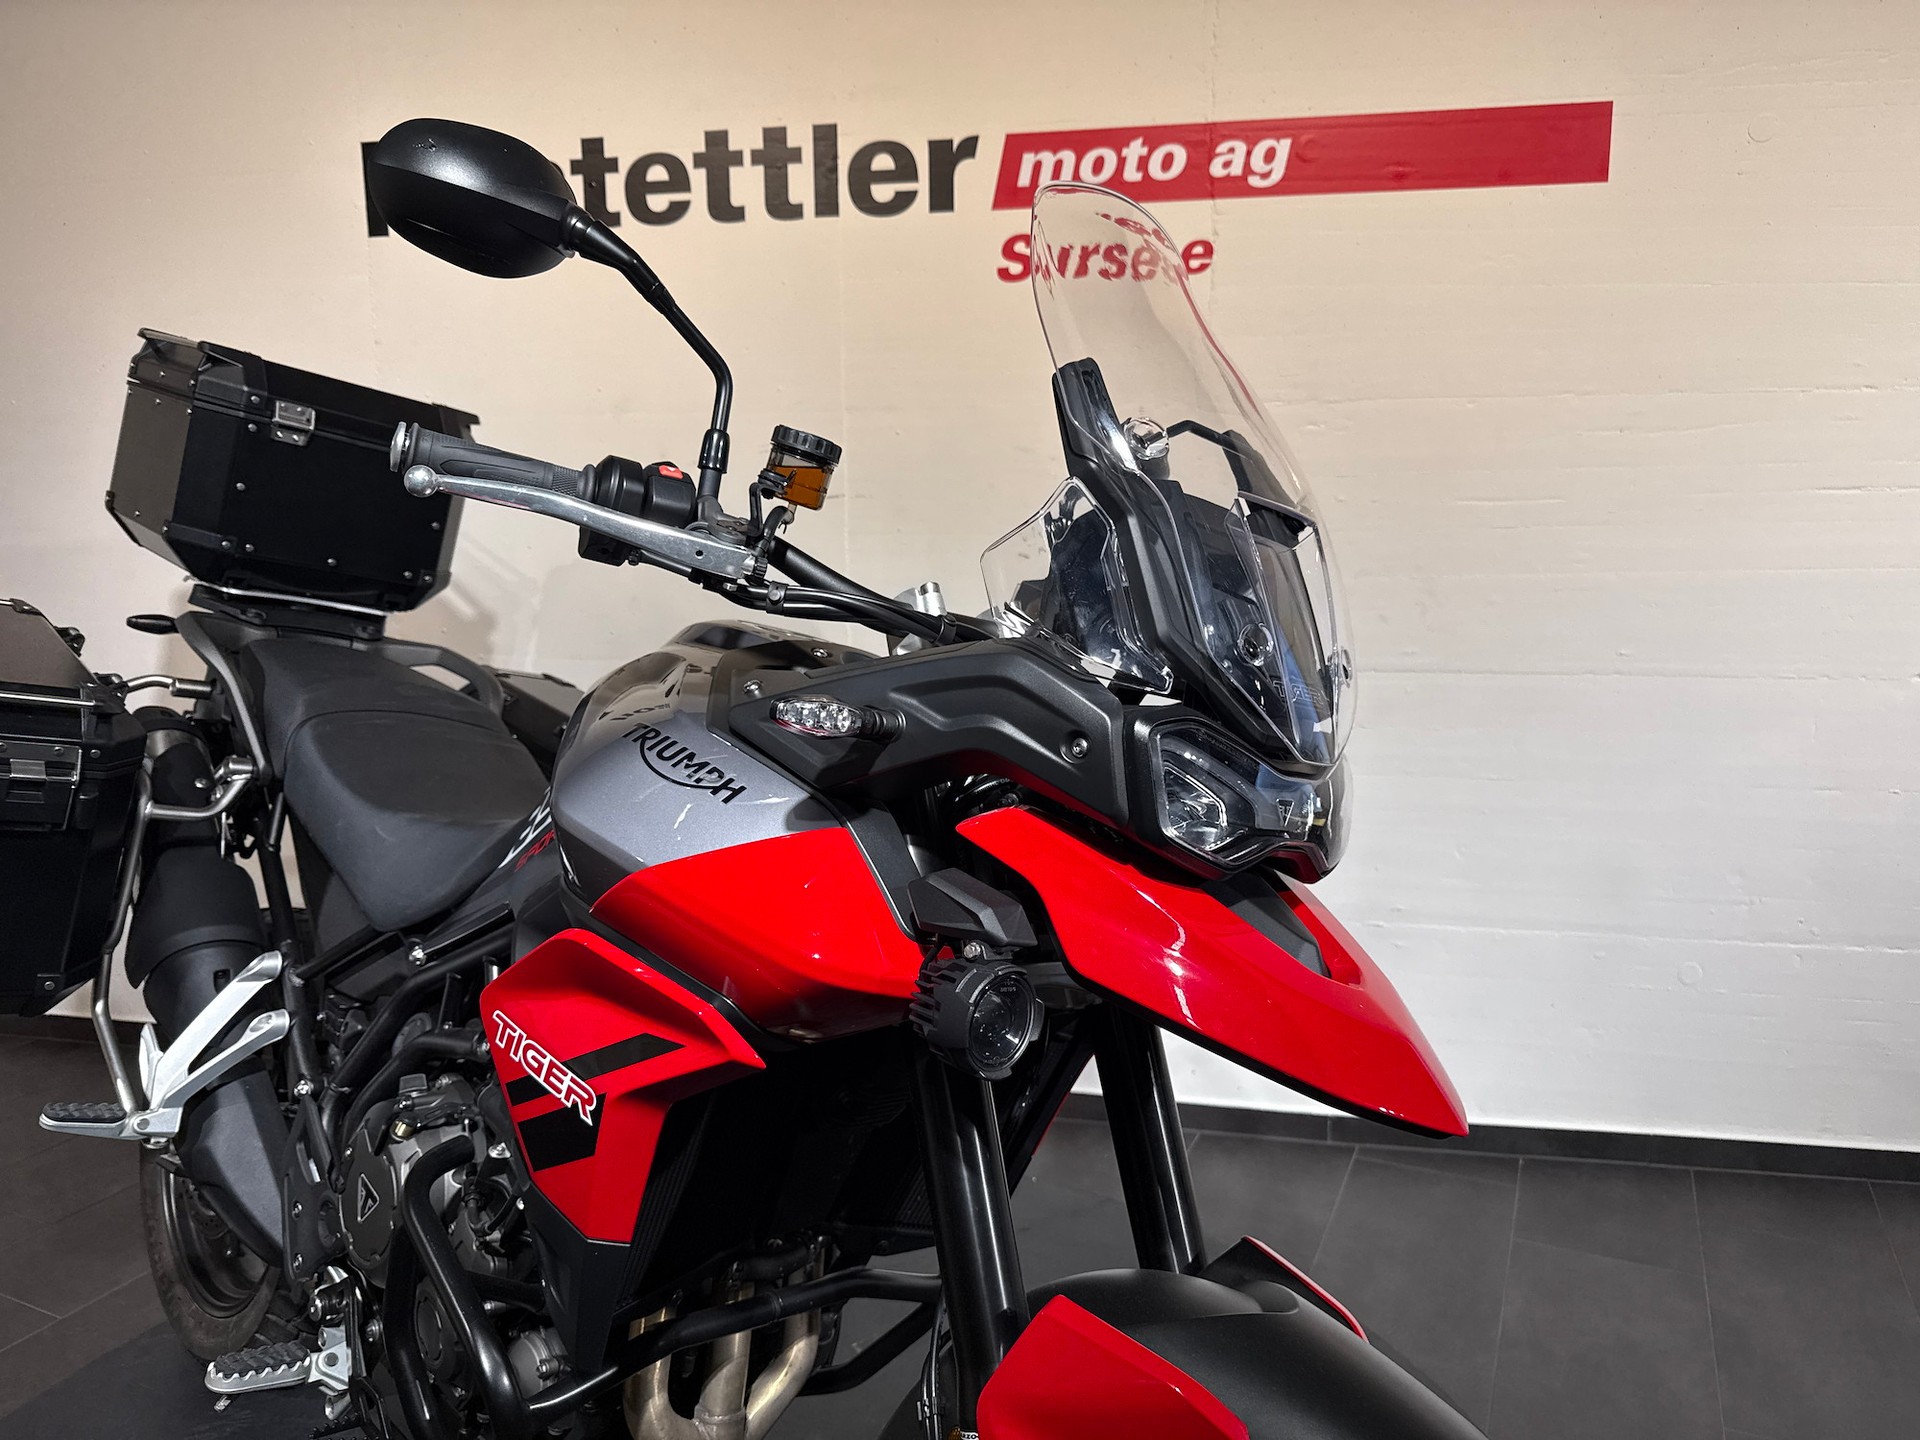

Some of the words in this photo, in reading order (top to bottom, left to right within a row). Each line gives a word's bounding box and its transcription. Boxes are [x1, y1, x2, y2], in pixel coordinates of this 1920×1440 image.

[1016, 136, 1188, 189] moto
[1208, 135, 1293, 188] ag
[1272, 679, 1326, 706] TGER
[622, 722, 748, 805] TRIUMPH
[492, 1009, 597, 1127] TIGER
